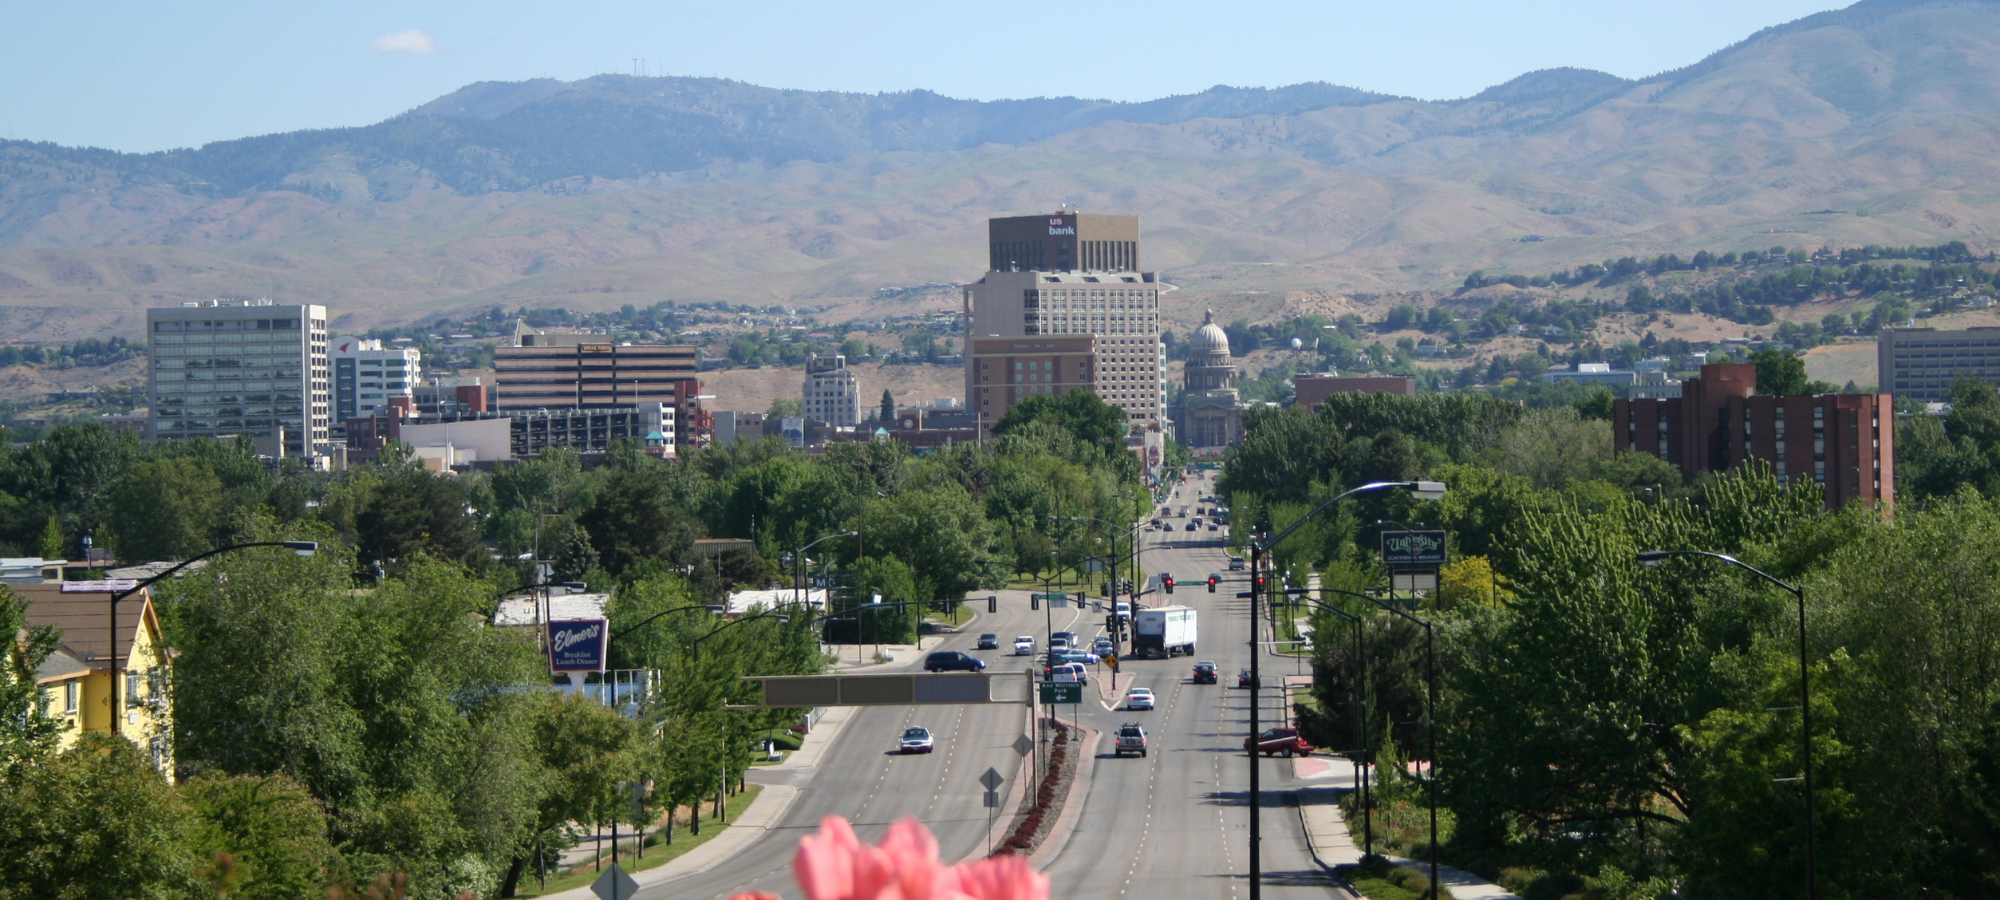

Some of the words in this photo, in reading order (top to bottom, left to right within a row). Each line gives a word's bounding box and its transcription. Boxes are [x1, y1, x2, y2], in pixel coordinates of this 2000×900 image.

[1049, 218, 1063, 226] us
[1048, 226, 1076, 235] bank
[554, 624, 600, 652] Elmer's
